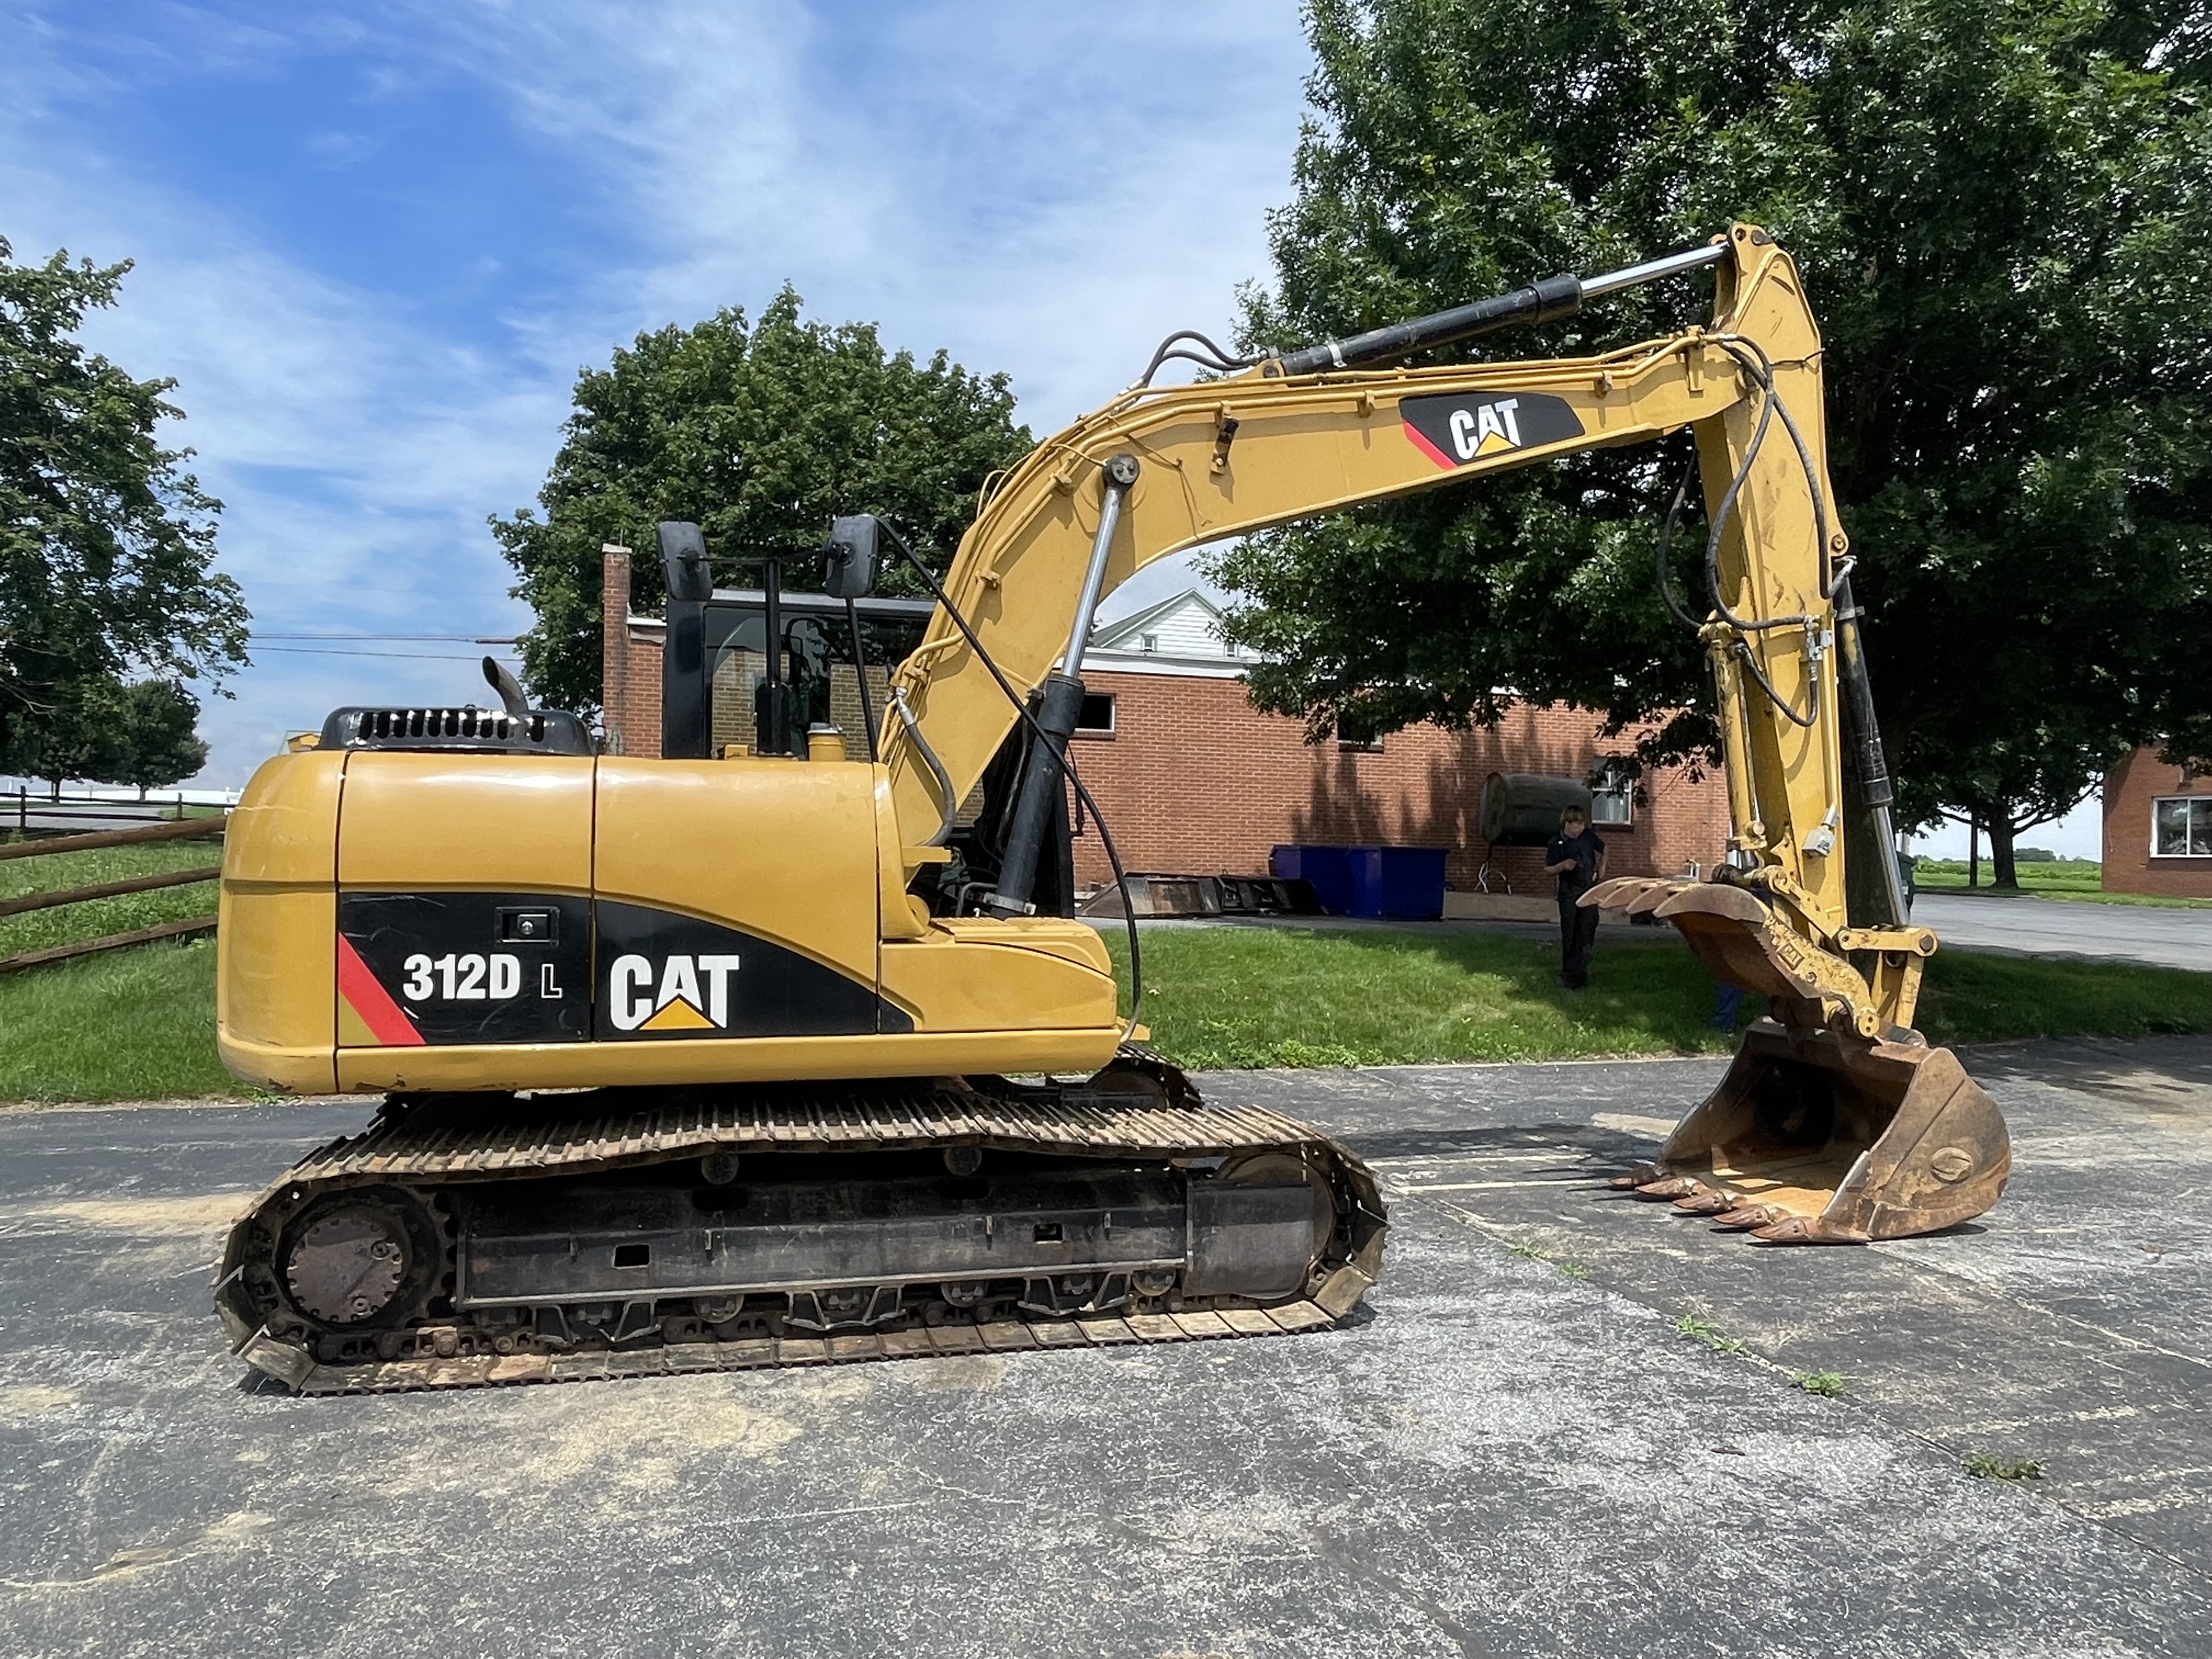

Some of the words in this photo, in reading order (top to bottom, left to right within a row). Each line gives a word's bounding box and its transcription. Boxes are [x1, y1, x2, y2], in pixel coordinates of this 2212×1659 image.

[1449, 398, 1521, 460] CAT
[403, 953, 520, 1000] 312D
[541, 963, 563, 998] L
[610, 954, 740, 1031] CAT
